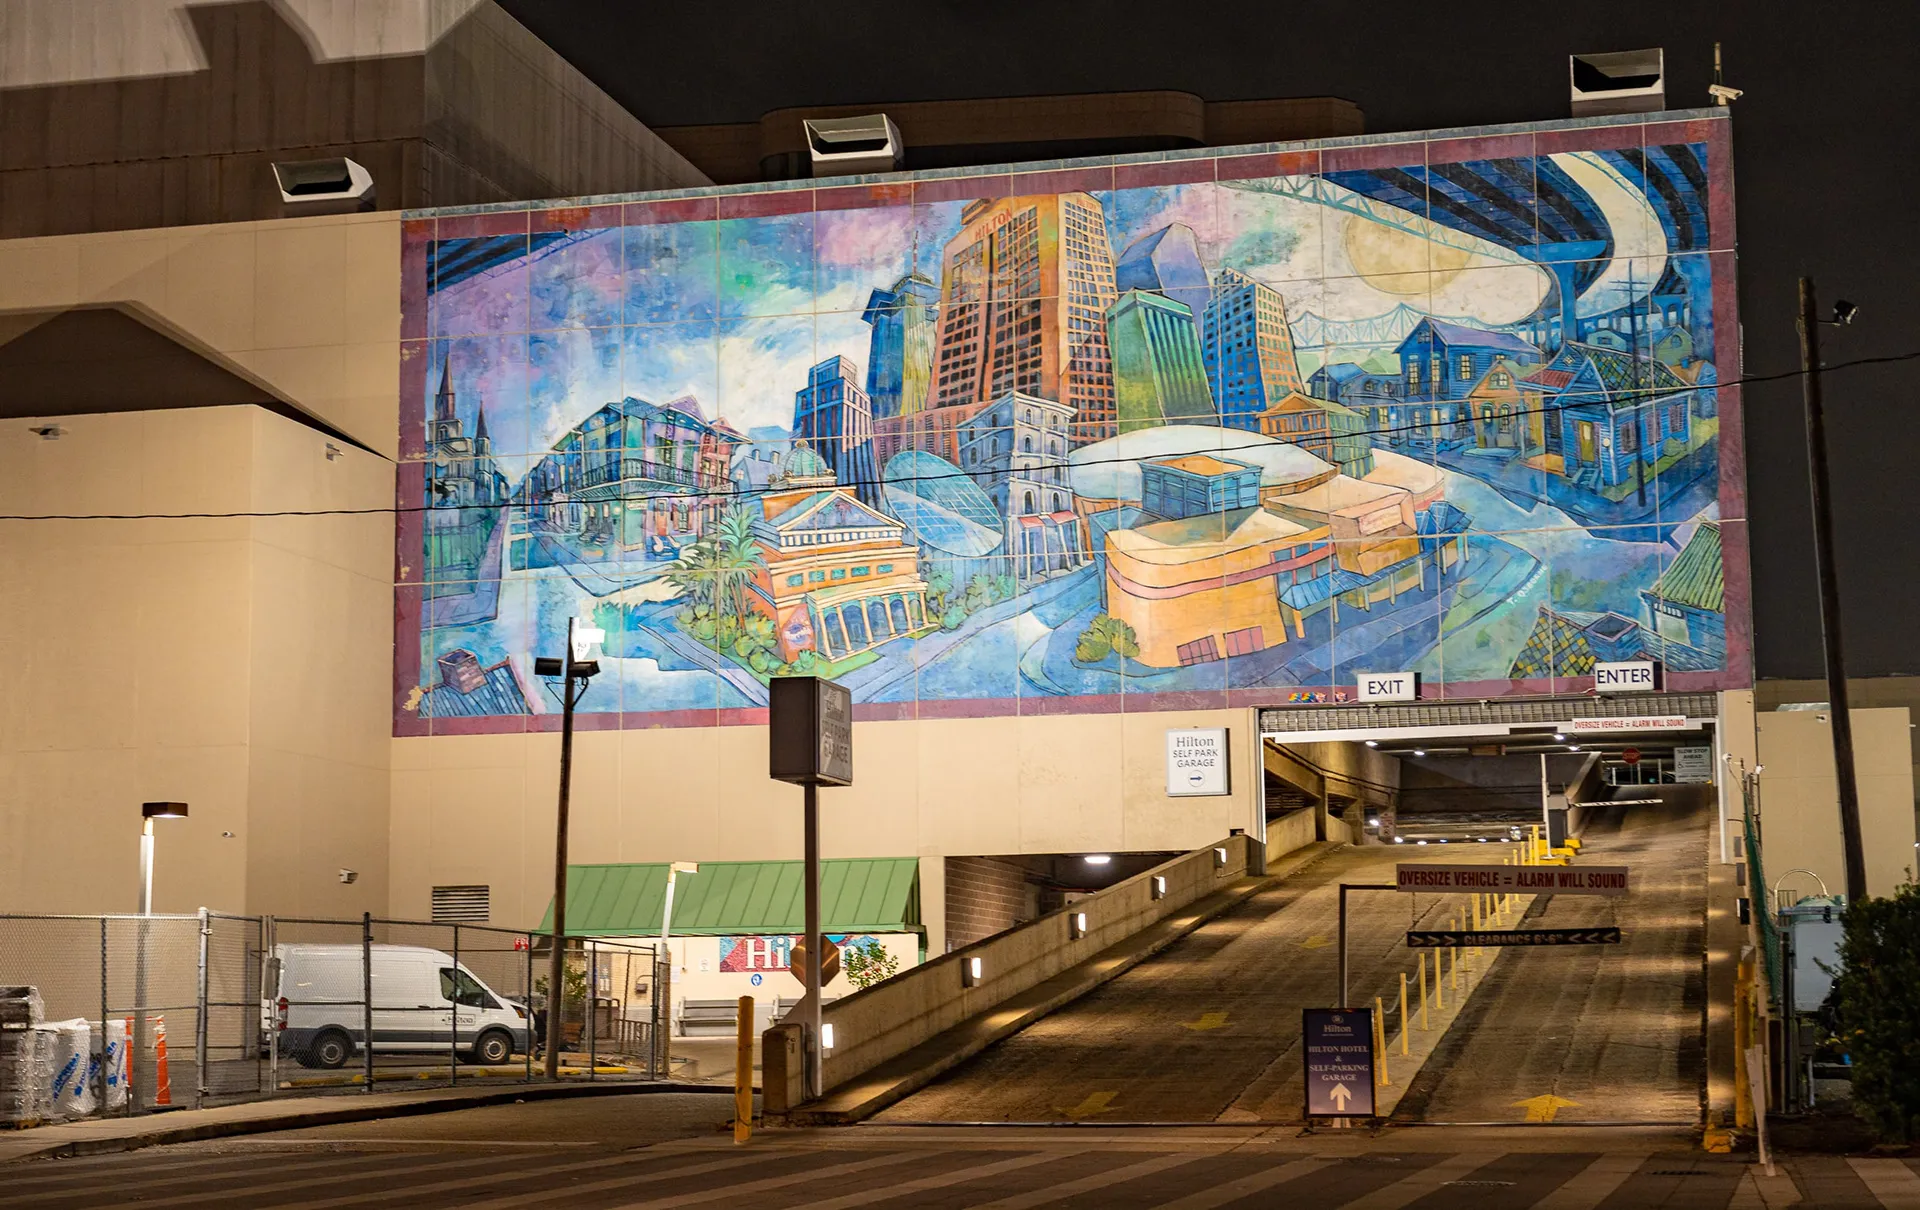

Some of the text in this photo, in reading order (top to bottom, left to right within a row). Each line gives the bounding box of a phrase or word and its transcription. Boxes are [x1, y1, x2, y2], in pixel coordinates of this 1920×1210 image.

[975, 208, 1012, 241] HILTON
[1597, 668, 1651, 684] ENTER
[1368, 679, 1404, 695] EXIT
[1574, 721, 1600, 729] OVERSIZE
[1601, 720, 1624, 728] VEHICLE
[1632, 719, 1651, 727] ALARM
[1652, 719, 1665, 727] WILL
[1666, 718, 1685, 727] SOUND
[1176, 736, 1214, 748] Hilton
[1173, 748, 1219, 758] SELF PARK
[1177, 758, 1215, 768] GARAGE
[1399, 870, 1451, 886] OVERSIZE
[1454, 870, 1499, 887] VEHICLE
[1516, 871, 1555, 888] ALARM
[1558, 872, 1585, 888] WILL
[1588, 873, 1625, 889] SOUND
[1463, 934, 1531, 946] CLEARANCE
[1324, 1024, 1352, 1033] Hilton
[1308, 1045, 1369, 1053] HILTON HOTEL
[1308, 1064, 1369, 1072] SELF-PARKING
[1321, 1073, 1358, 1081] GARAGE
